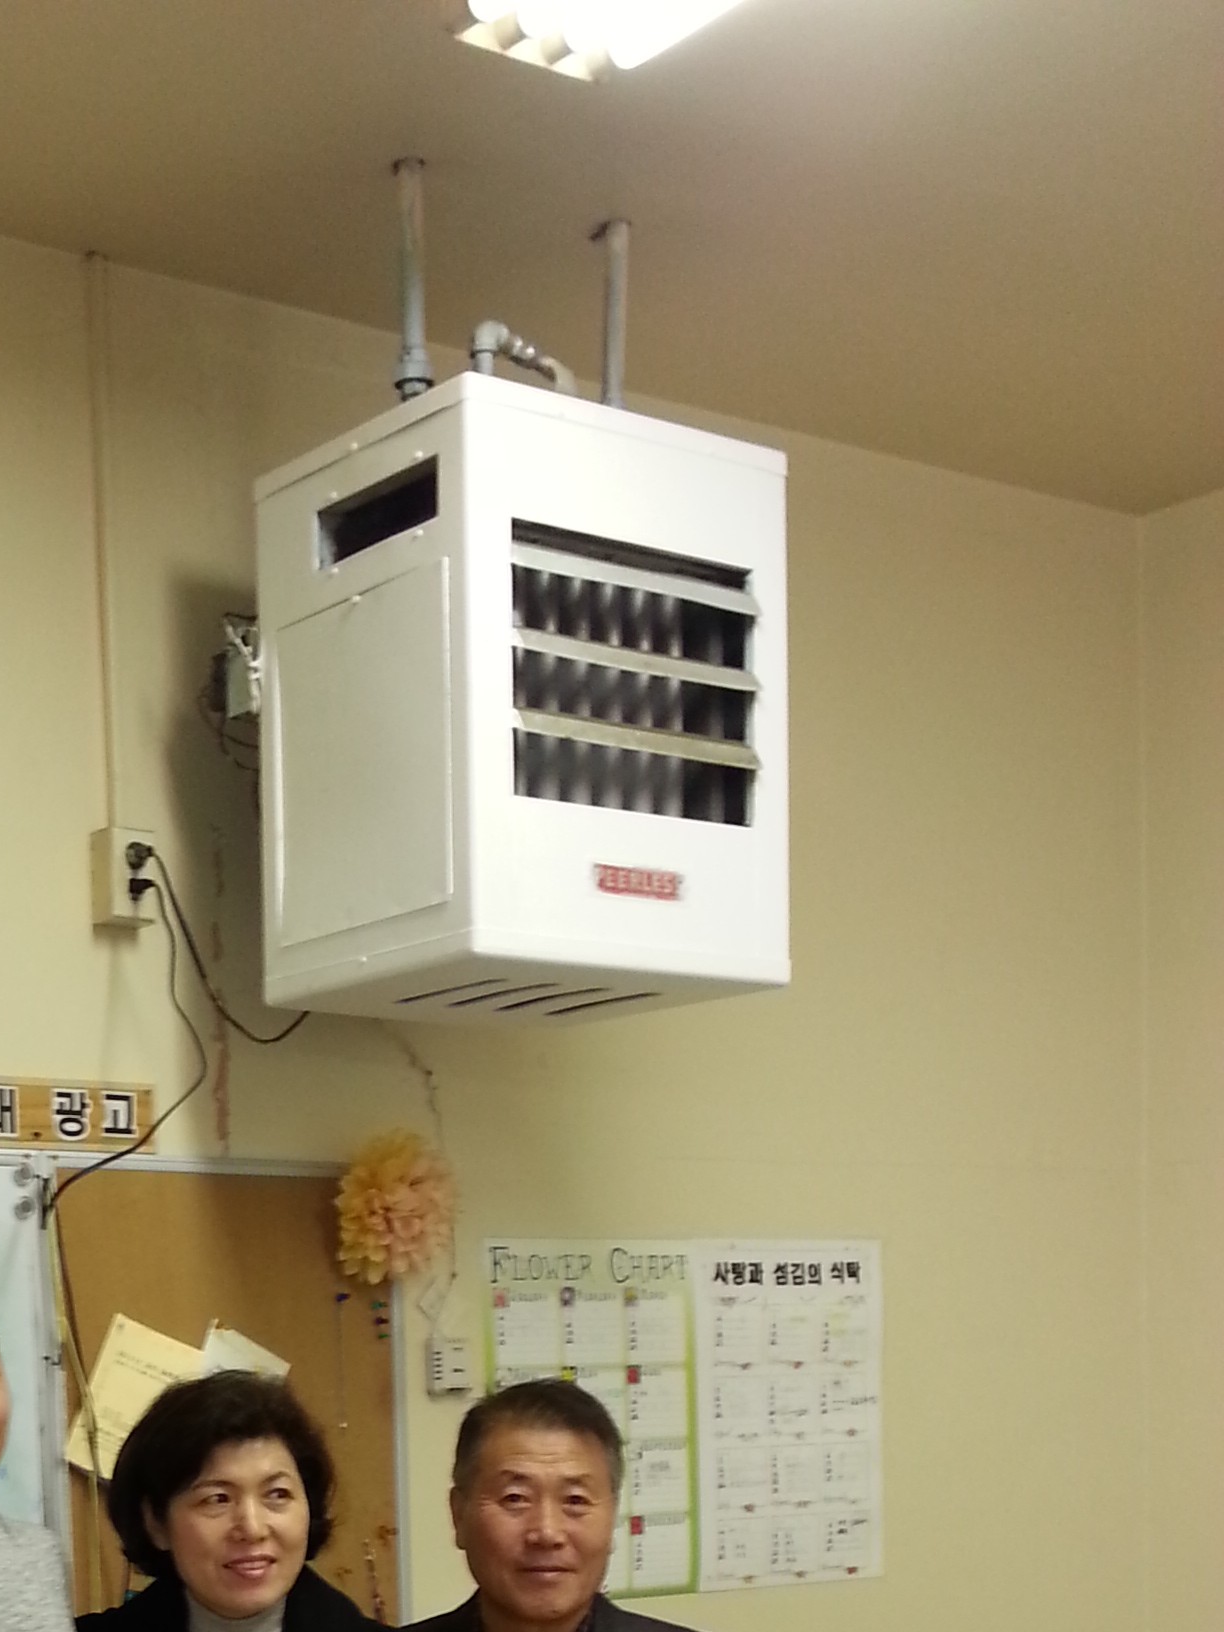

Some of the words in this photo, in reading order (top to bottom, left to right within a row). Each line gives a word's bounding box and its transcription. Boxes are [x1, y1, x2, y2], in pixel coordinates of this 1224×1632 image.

[53, 1090, 137, 1137] 광고
[713, 1261, 764, 1286] 사랑과
[773, 1261, 823, 1286] 섬김의
[831, 1261, 862, 1285] 식탁
